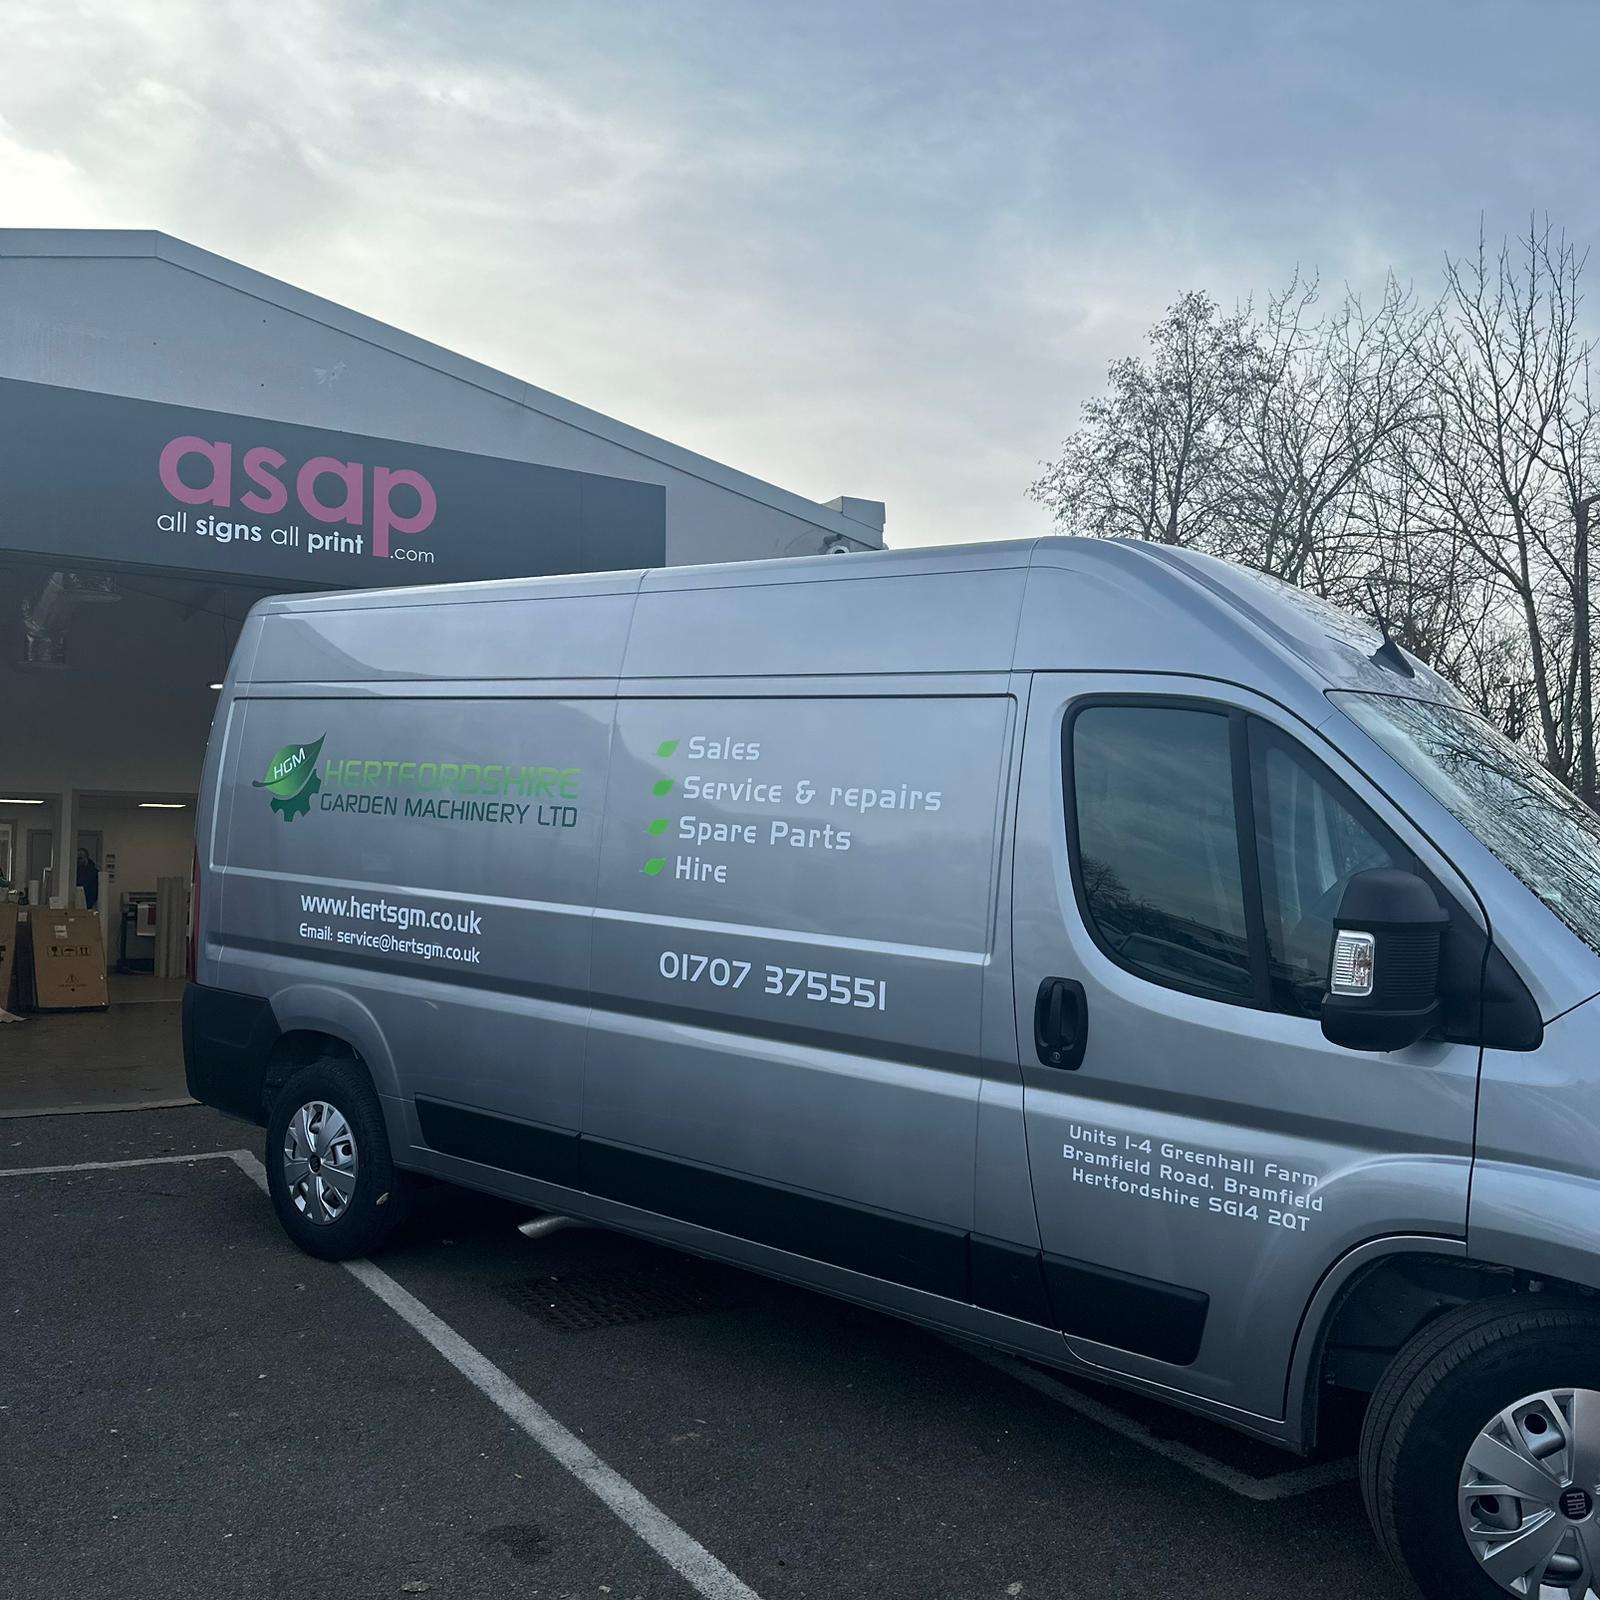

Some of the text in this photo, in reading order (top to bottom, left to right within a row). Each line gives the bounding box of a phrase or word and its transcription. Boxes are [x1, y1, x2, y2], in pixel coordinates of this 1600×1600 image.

[158, 435, 438, 558] asap
[157, 511, 364, 554] all signs all print
[389, 548, 435, 564] .com
[272, 747, 306, 780] HGM
[687, 736, 760, 761] Sales
[324, 760, 582, 800] HERTFORDSHIRE
[683, 775, 942, 814] Service & repairs
[320, 793, 578, 828] GARDEN MACHINERY LTD
[678, 815, 852, 851] Spare Parts
[674, 855, 728, 884] Hire
[300, 894, 482, 935] www.hertsgm.co.uk
[299, 922, 480, 964] Email: service@hertsgm.co.uk
[658, 951, 887, 1011] 01707 375551
[1069, 1124, 1118, 1148] Units
[1160, 1143, 1254, 1175] Greenhall
[1264, 1163, 1319, 1188] Farm
[1062, 1144, 1150, 1176] Bramfield
[1224, 1176, 1324, 1212] Bramfield
[1072, 1167, 1310, 1232] Hertfordshire SG14 2QT
[1566, 1491, 1587, 1515] FIAT
